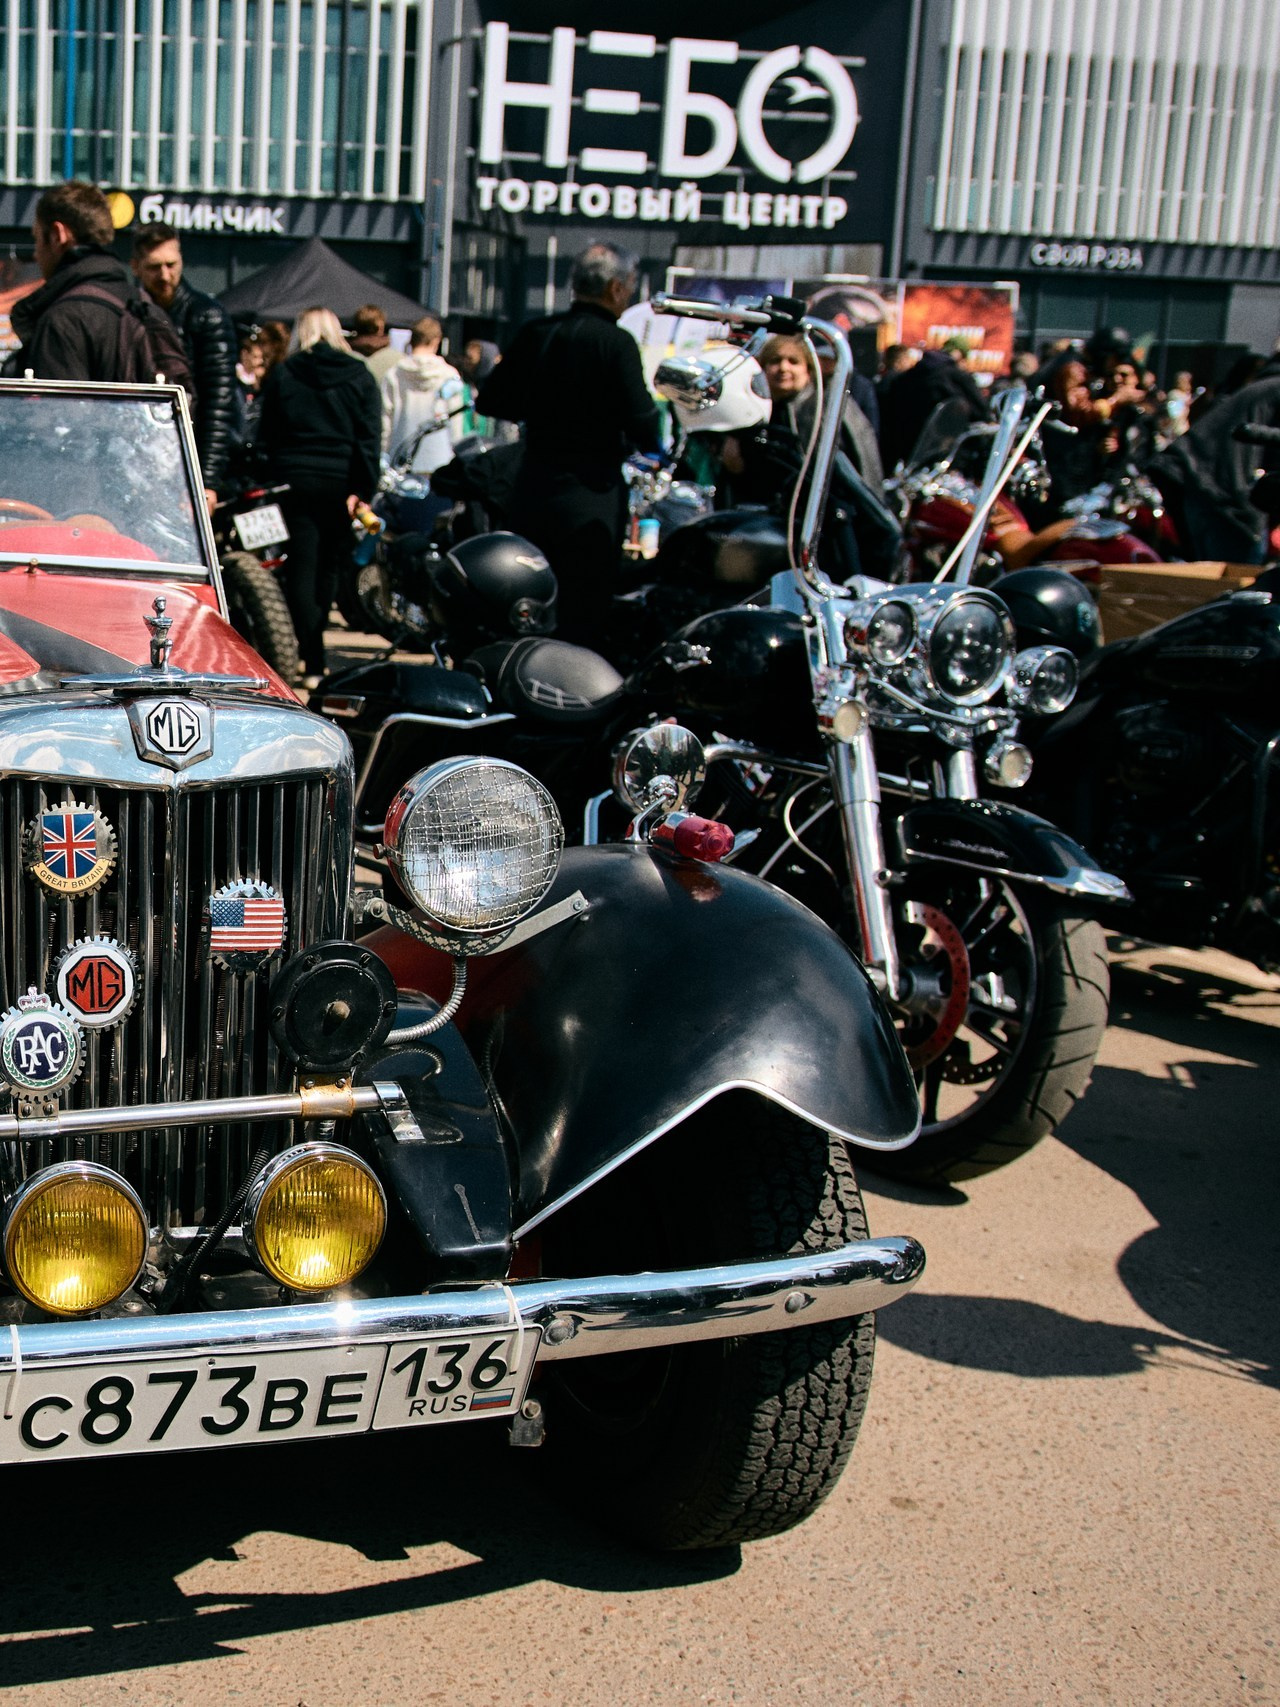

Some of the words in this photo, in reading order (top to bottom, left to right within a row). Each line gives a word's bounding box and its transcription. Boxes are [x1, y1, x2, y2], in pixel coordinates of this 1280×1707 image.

[480, 21, 858, 183] НЕБО
[476, 176, 702, 223] ТОРГОВЫЙ
[723, 190, 848, 229] ЦЕНТР
[153, 706, 196, 748] MG
[39, 869, 68, 888] GREAT
[71, 865, 104, 889] BRITAIN
[72, 961, 120, 1009] MG
[16, 1025, 65, 1075] RAC
[392, 1340, 506, 1398] 136
[408, 1394, 467, 1417] RUS
